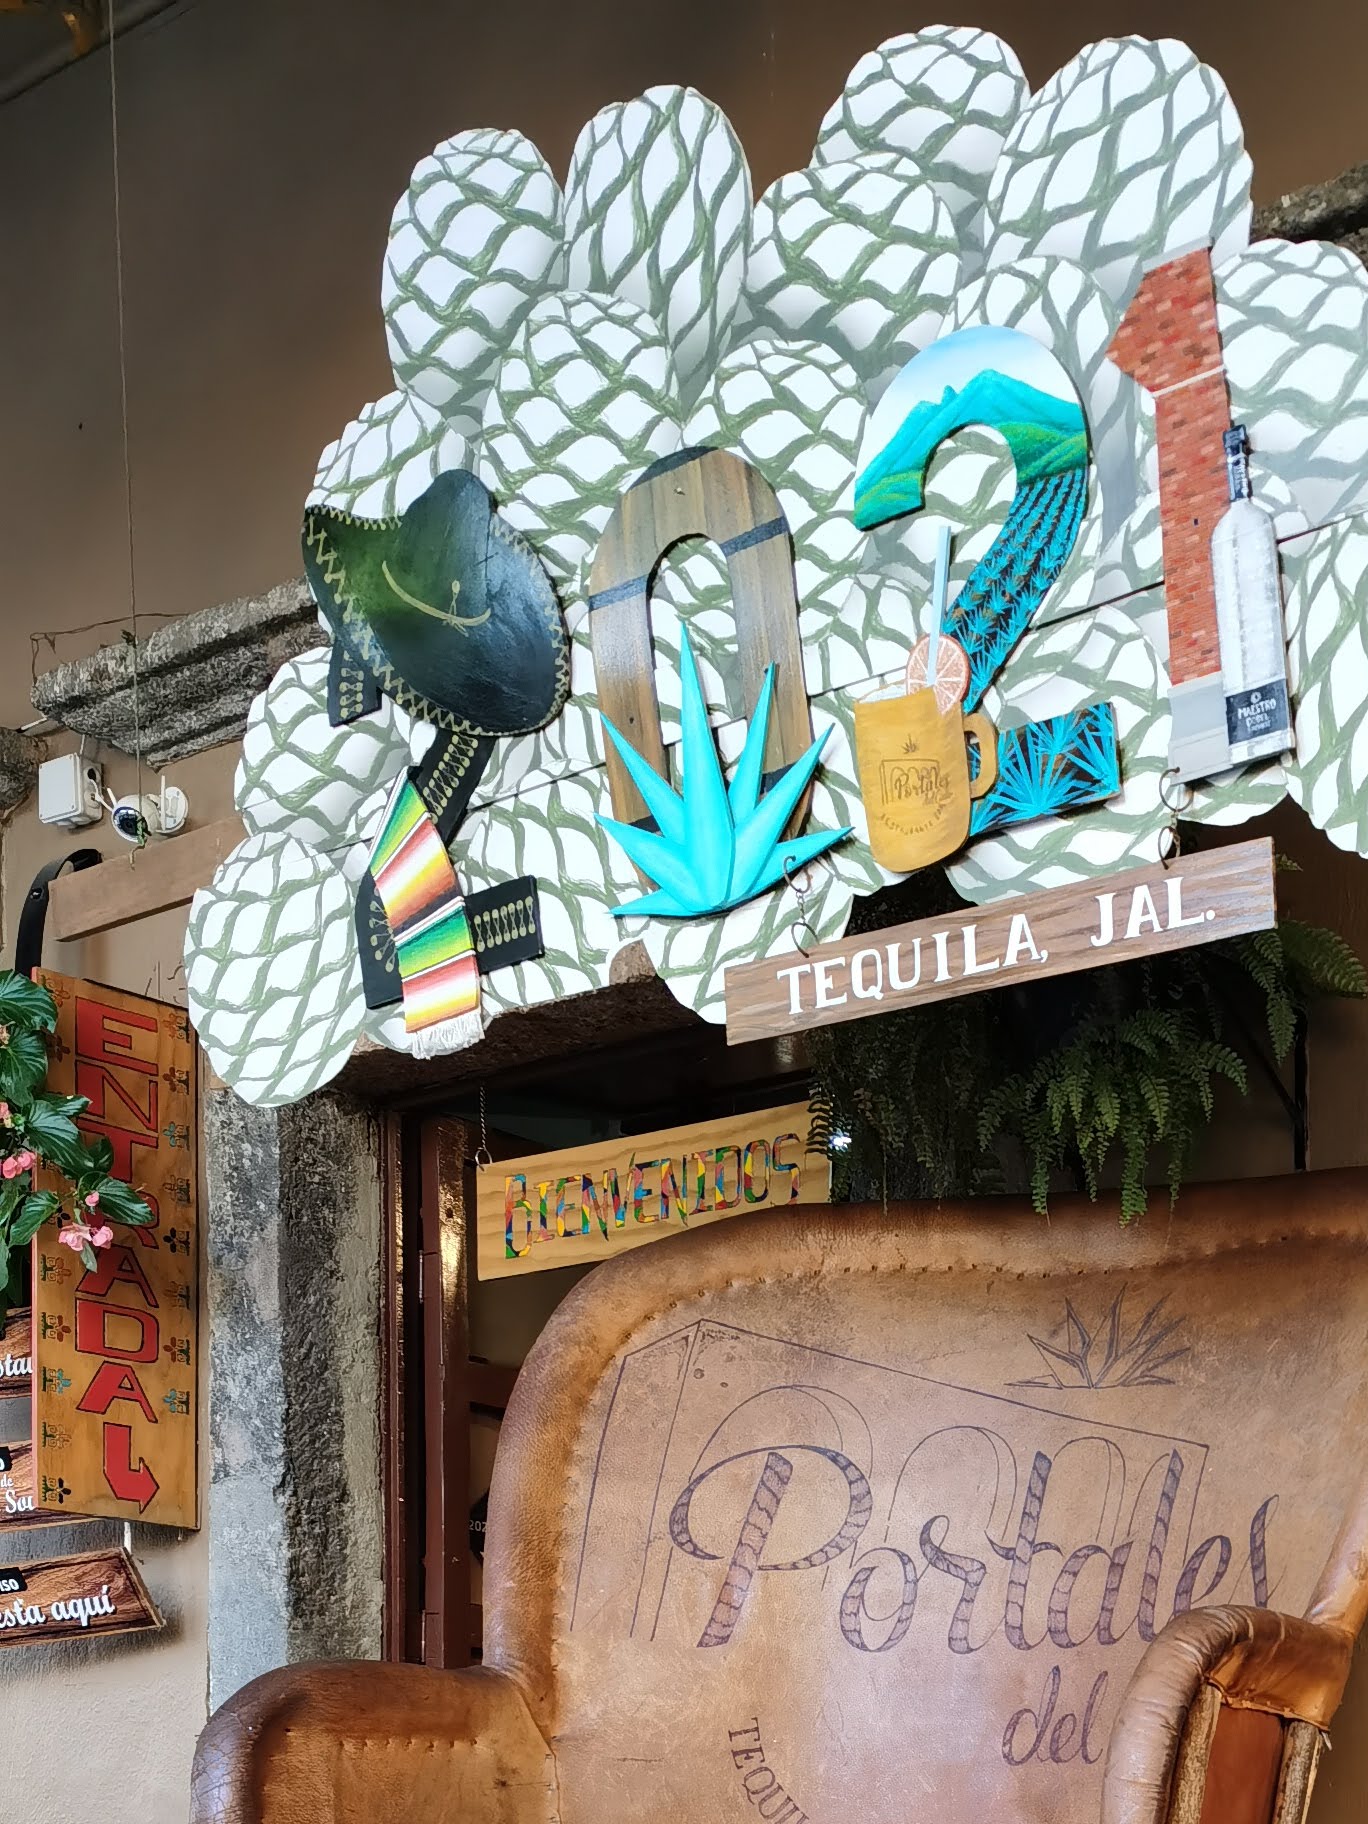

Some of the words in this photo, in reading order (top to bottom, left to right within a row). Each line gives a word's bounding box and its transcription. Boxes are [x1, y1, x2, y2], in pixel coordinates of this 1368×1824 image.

[776, 921, 1050, 1017] TEQUILA,
[1087, 875, 1216, 950] JAL.
[504, 1132, 801, 1260] BIENVENIDOS
[50, 1584, 116, 1627] aquí
[1001, 1664, 1109, 1767] del
